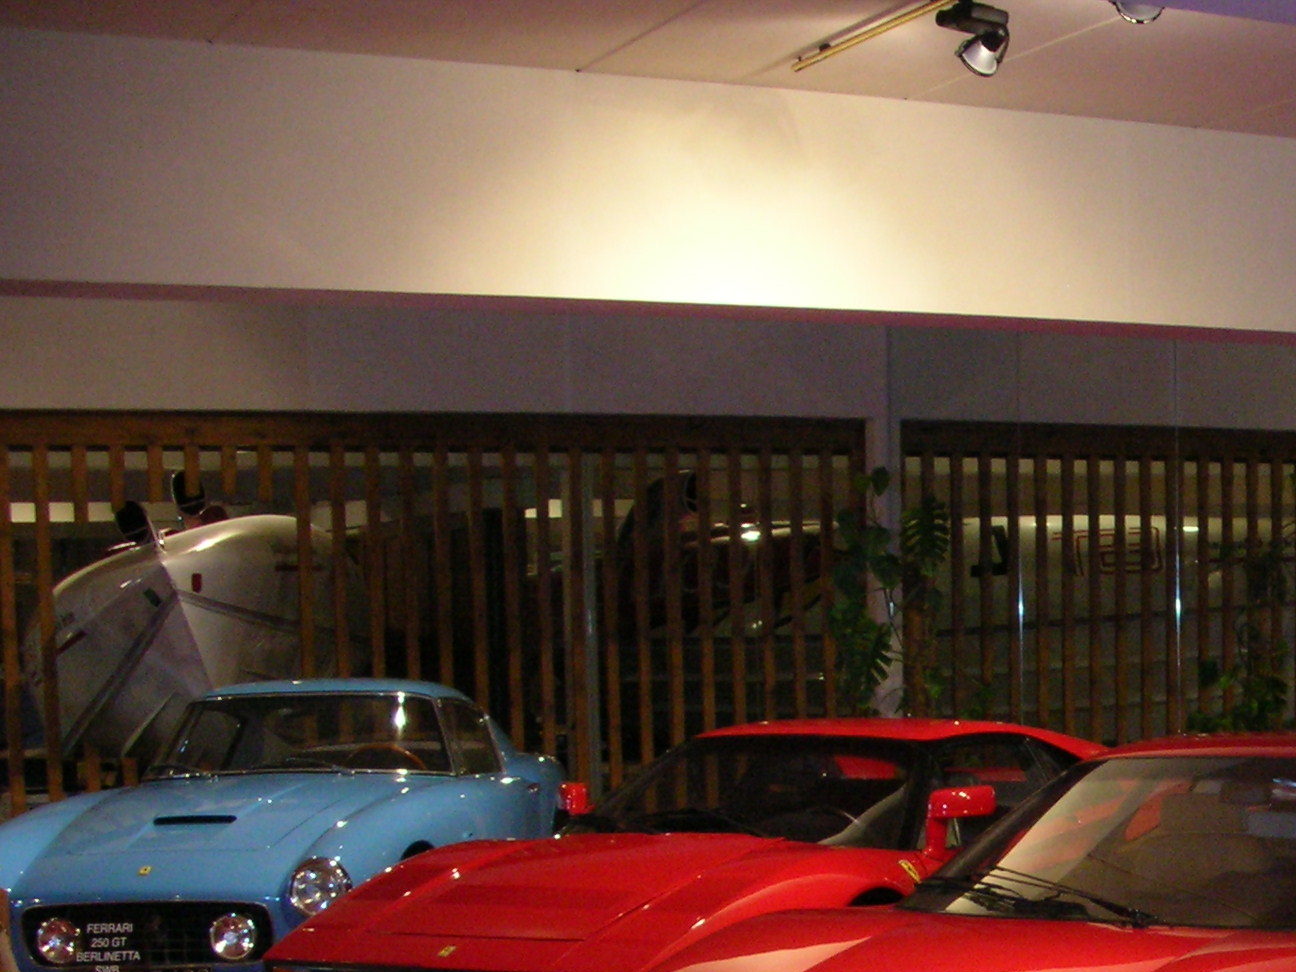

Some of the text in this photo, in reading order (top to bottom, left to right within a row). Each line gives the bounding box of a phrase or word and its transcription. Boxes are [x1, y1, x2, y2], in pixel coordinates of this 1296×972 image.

[87, 922, 133, 933] FERRARI
[91, 937, 127, 947] 250 GT
[76, 951, 141, 961] BERLINETTA
